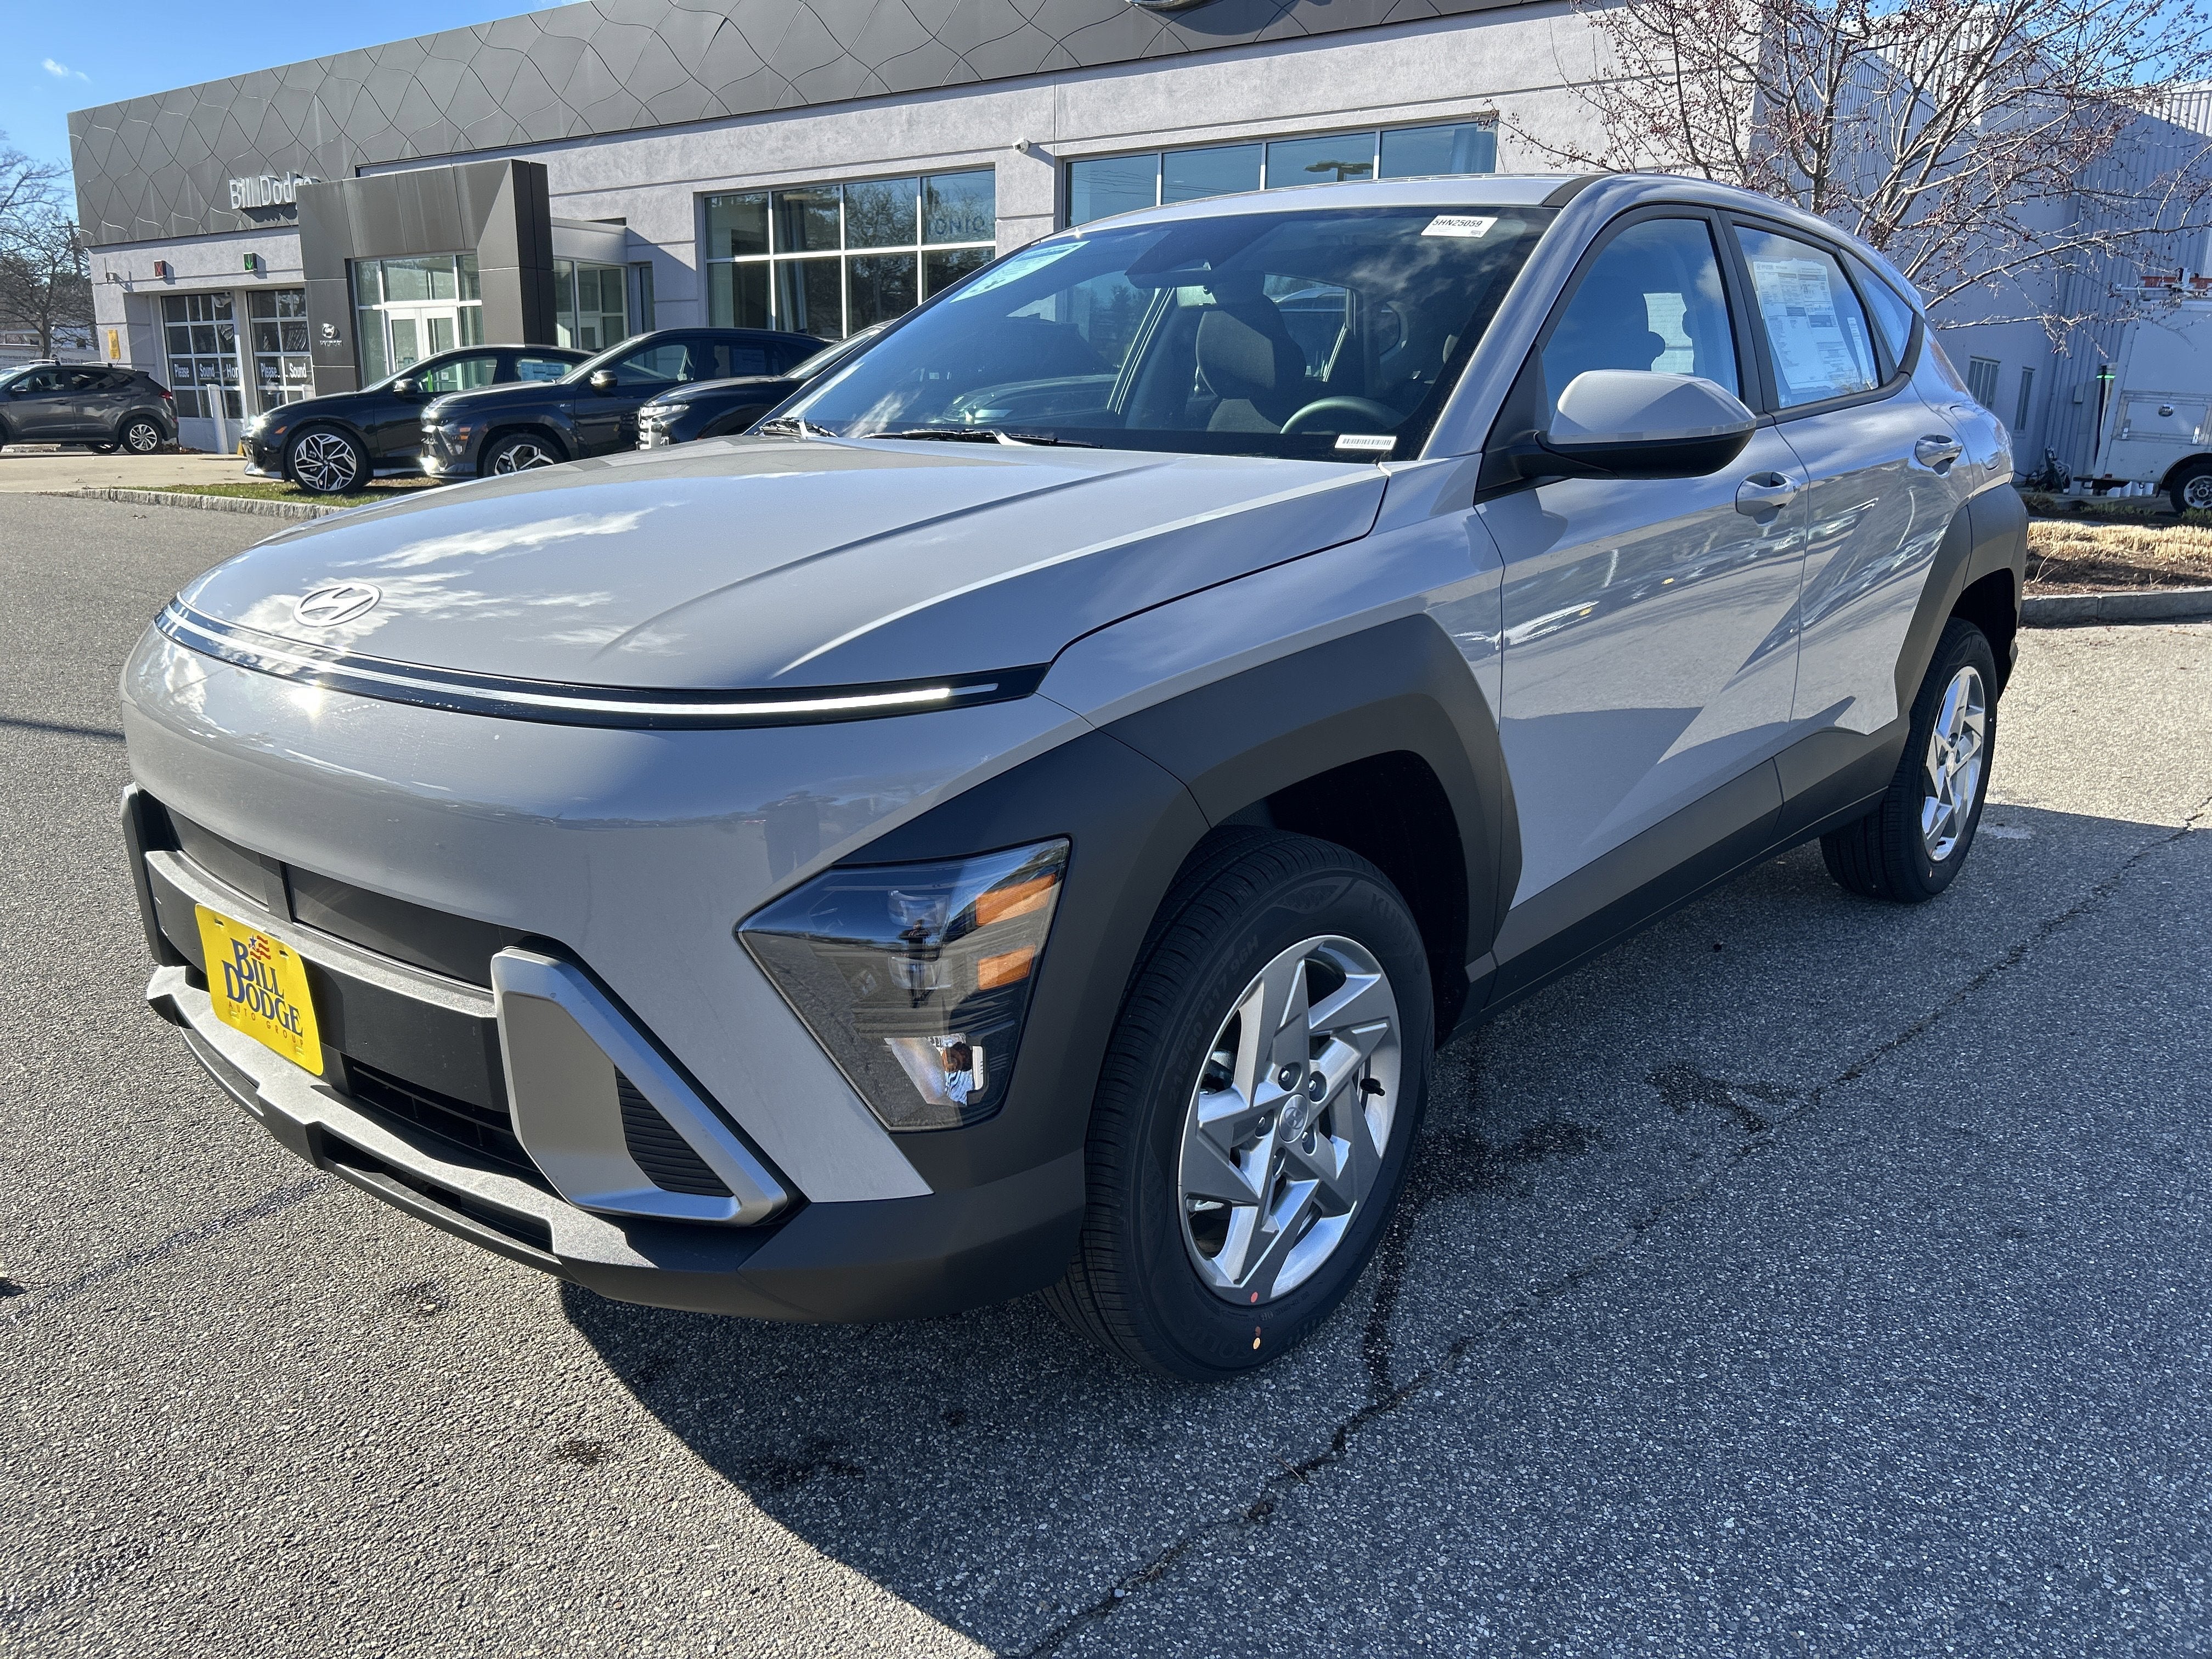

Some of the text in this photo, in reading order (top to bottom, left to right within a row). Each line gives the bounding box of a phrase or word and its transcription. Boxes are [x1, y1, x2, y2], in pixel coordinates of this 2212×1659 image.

[229, 177, 258, 210] Bill
[174, 363, 238, 378] Please Sound Hor
[290, 363, 307, 378] Sound
[230, 938, 284, 998] BILL
[222, 960, 303, 1037] DODGE
[228, 1001, 303, 1045] AUTO GROUP
